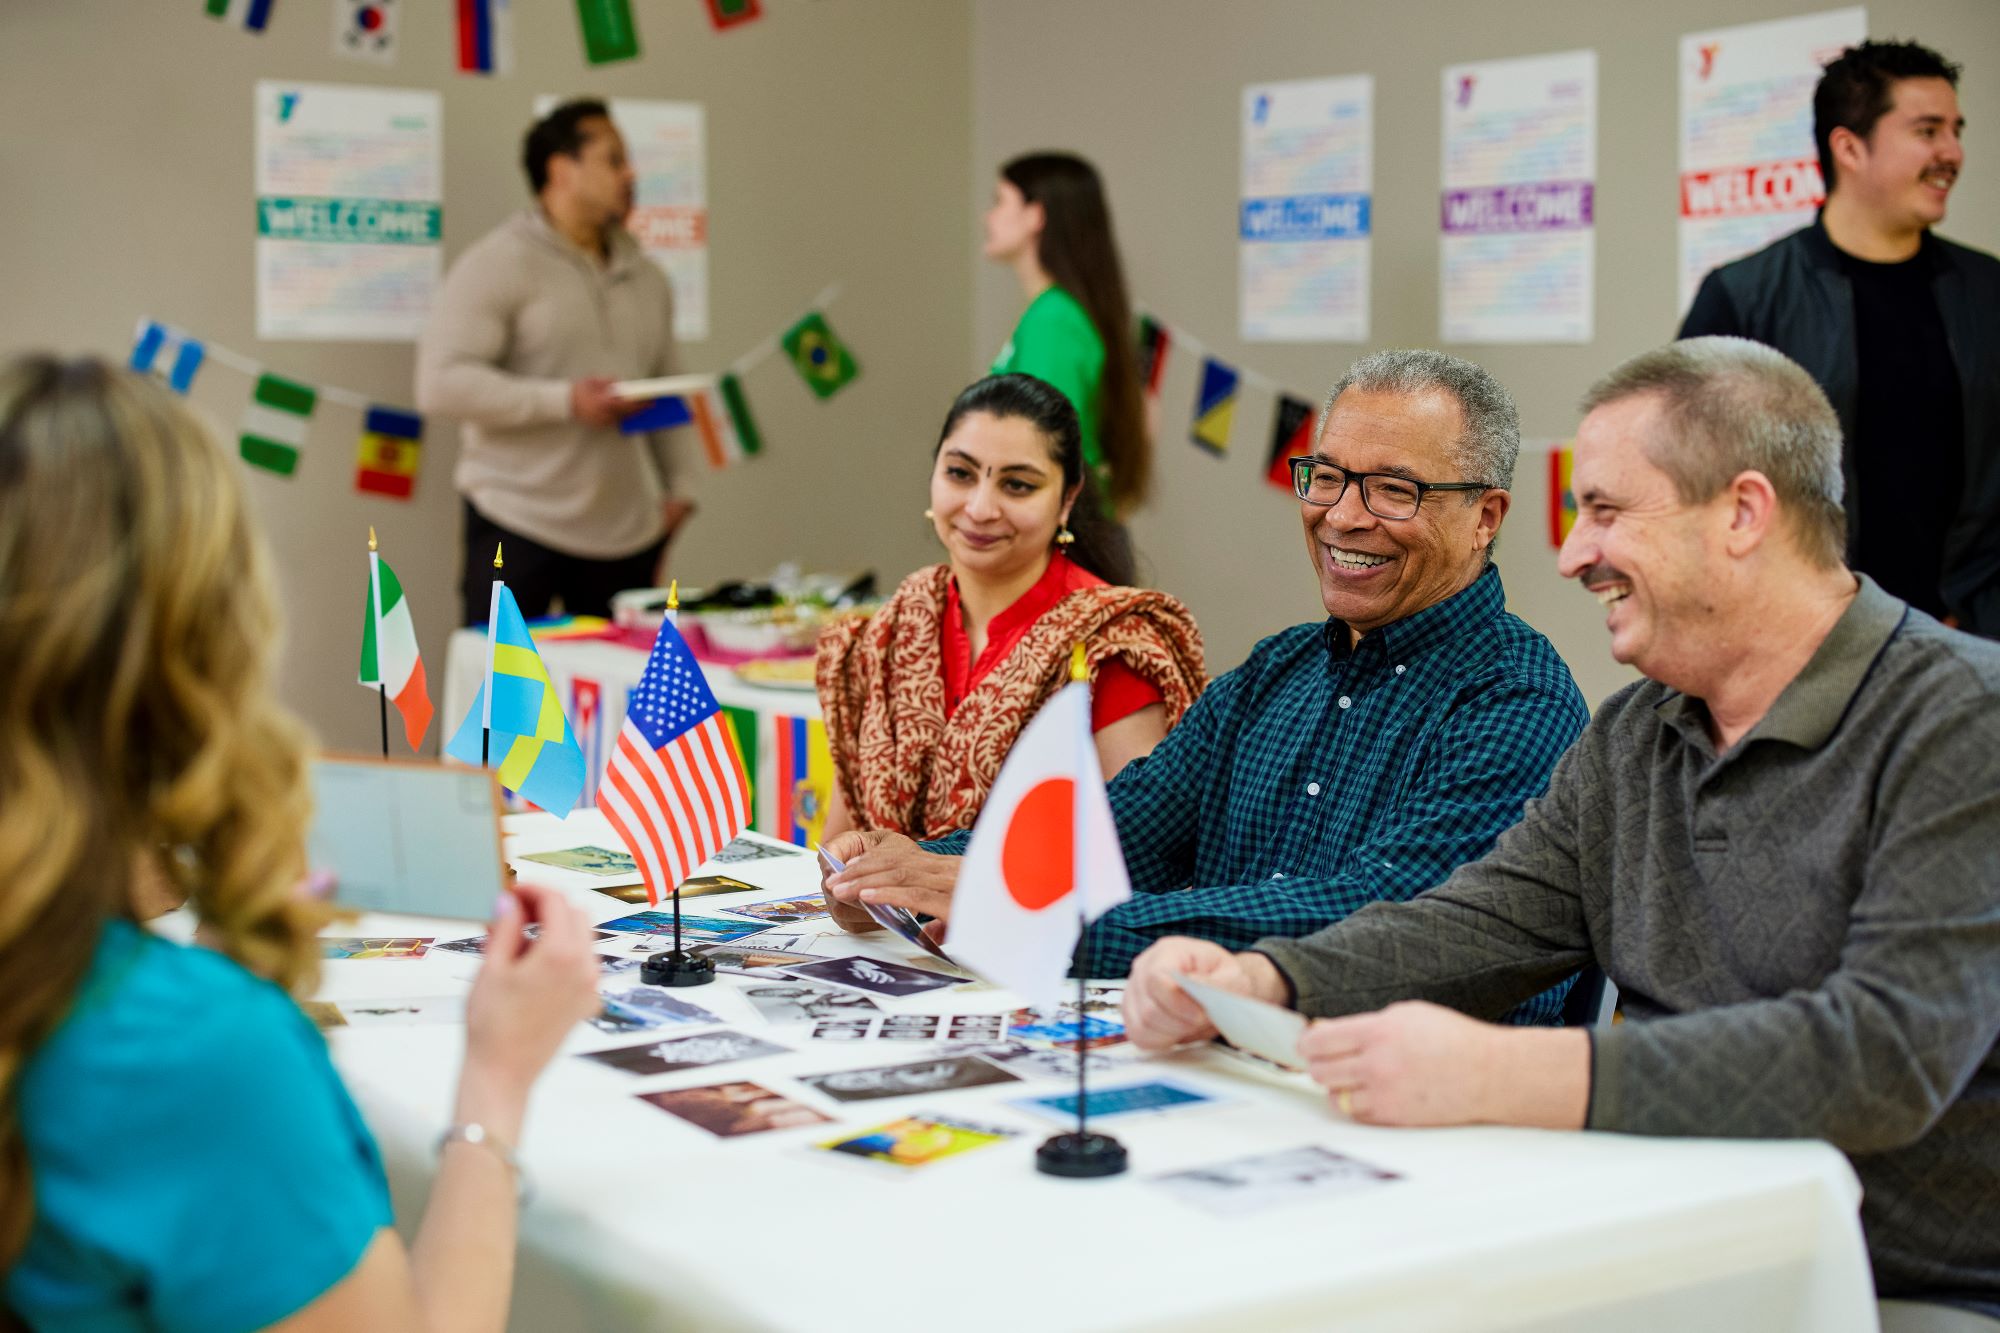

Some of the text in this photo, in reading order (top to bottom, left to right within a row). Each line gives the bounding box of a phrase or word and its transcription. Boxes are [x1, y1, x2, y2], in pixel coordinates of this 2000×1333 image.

[264, 202, 428, 240] WELCOME
[1245, 197, 1358, 238] WELCOME
[1446, 187, 1580, 229] WELCOME
